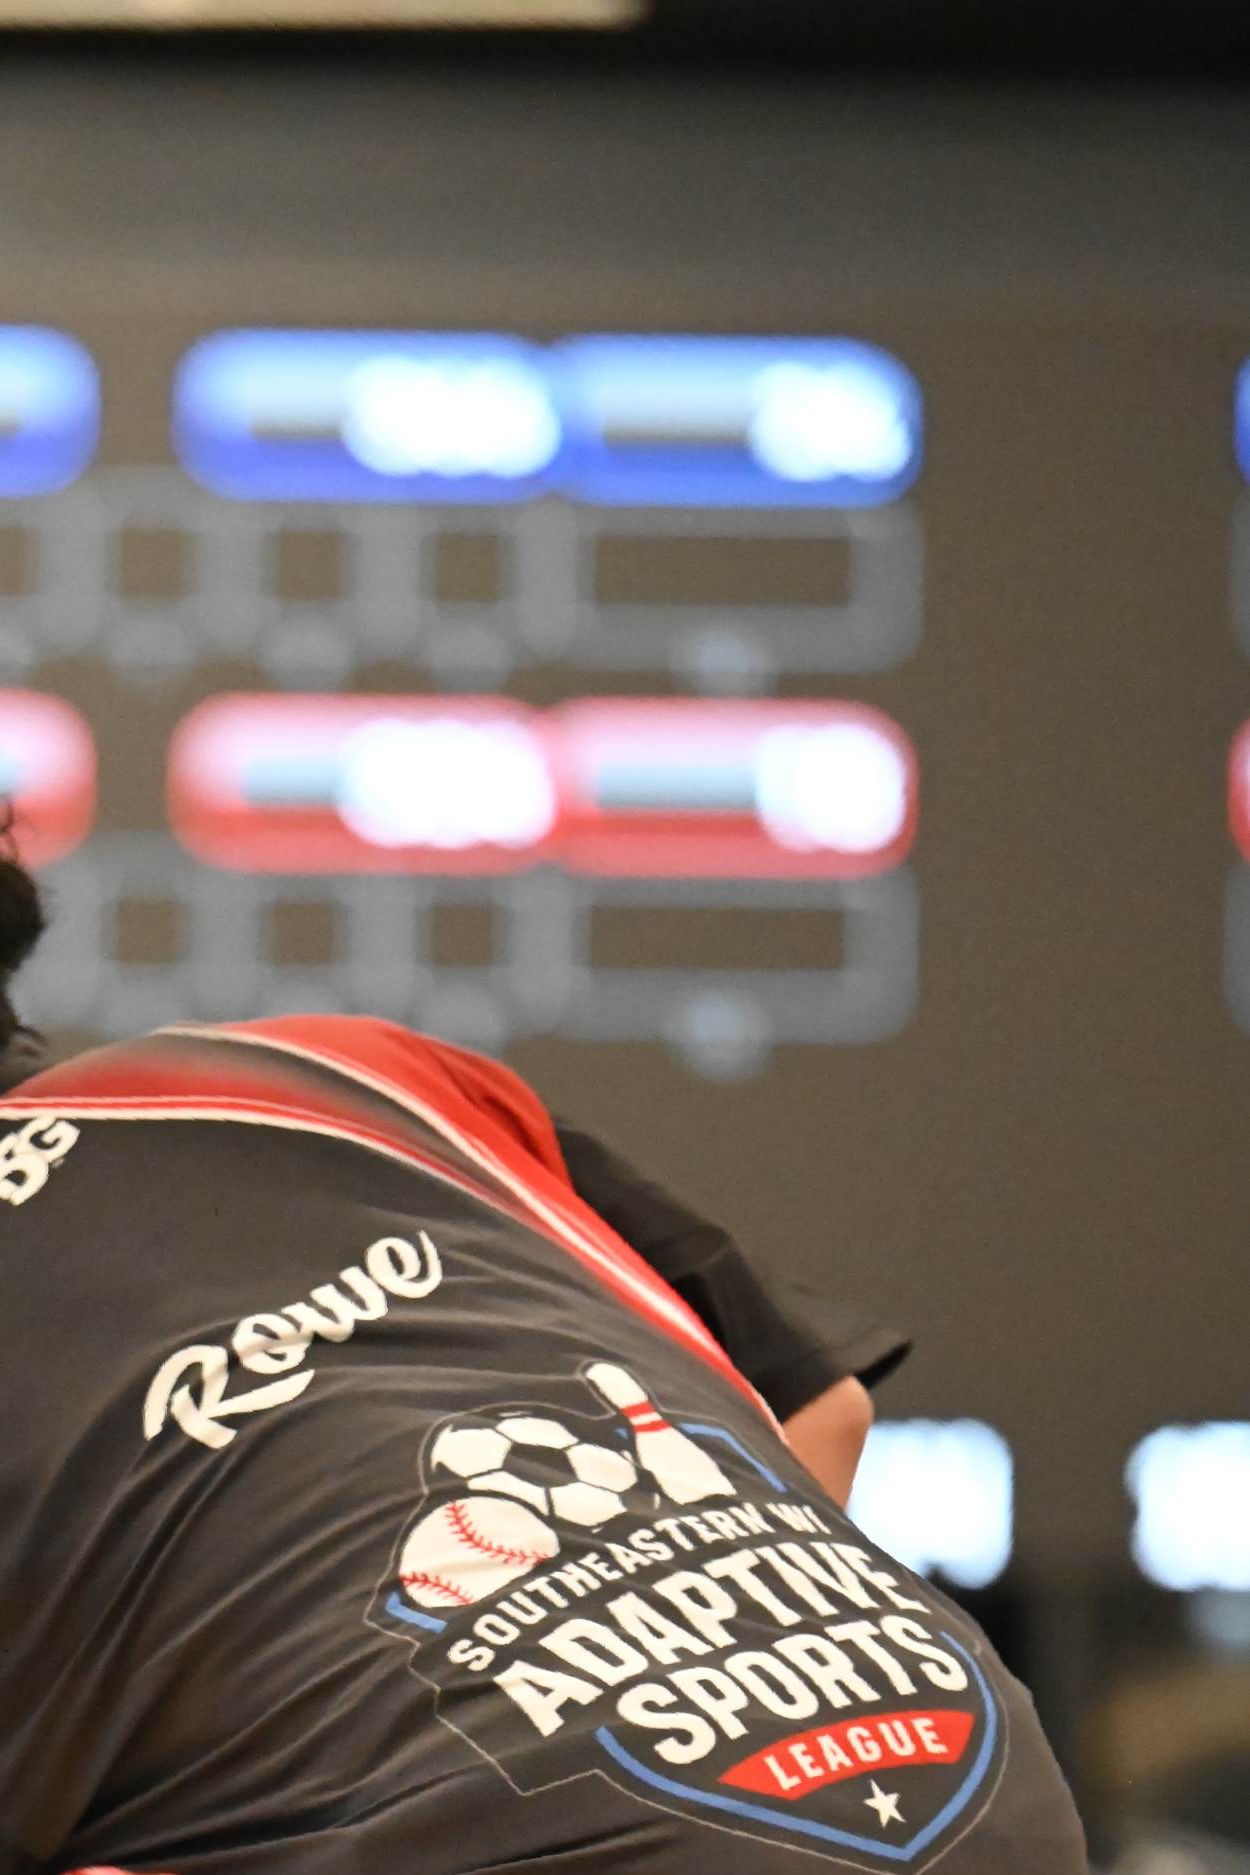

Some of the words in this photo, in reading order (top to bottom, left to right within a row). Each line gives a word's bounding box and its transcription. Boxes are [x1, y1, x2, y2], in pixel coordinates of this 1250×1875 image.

[142, 1229, 442, 1450] Rowe
[448, 1501, 776, 1672] SOUTHEASTERN
[765, 1502, 832, 1534] WI
[492, 1541, 931, 1737] ADAPTIVE
[617, 1615, 968, 1765] SPORTS
[764, 1717, 949, 1792] LEAGUE
